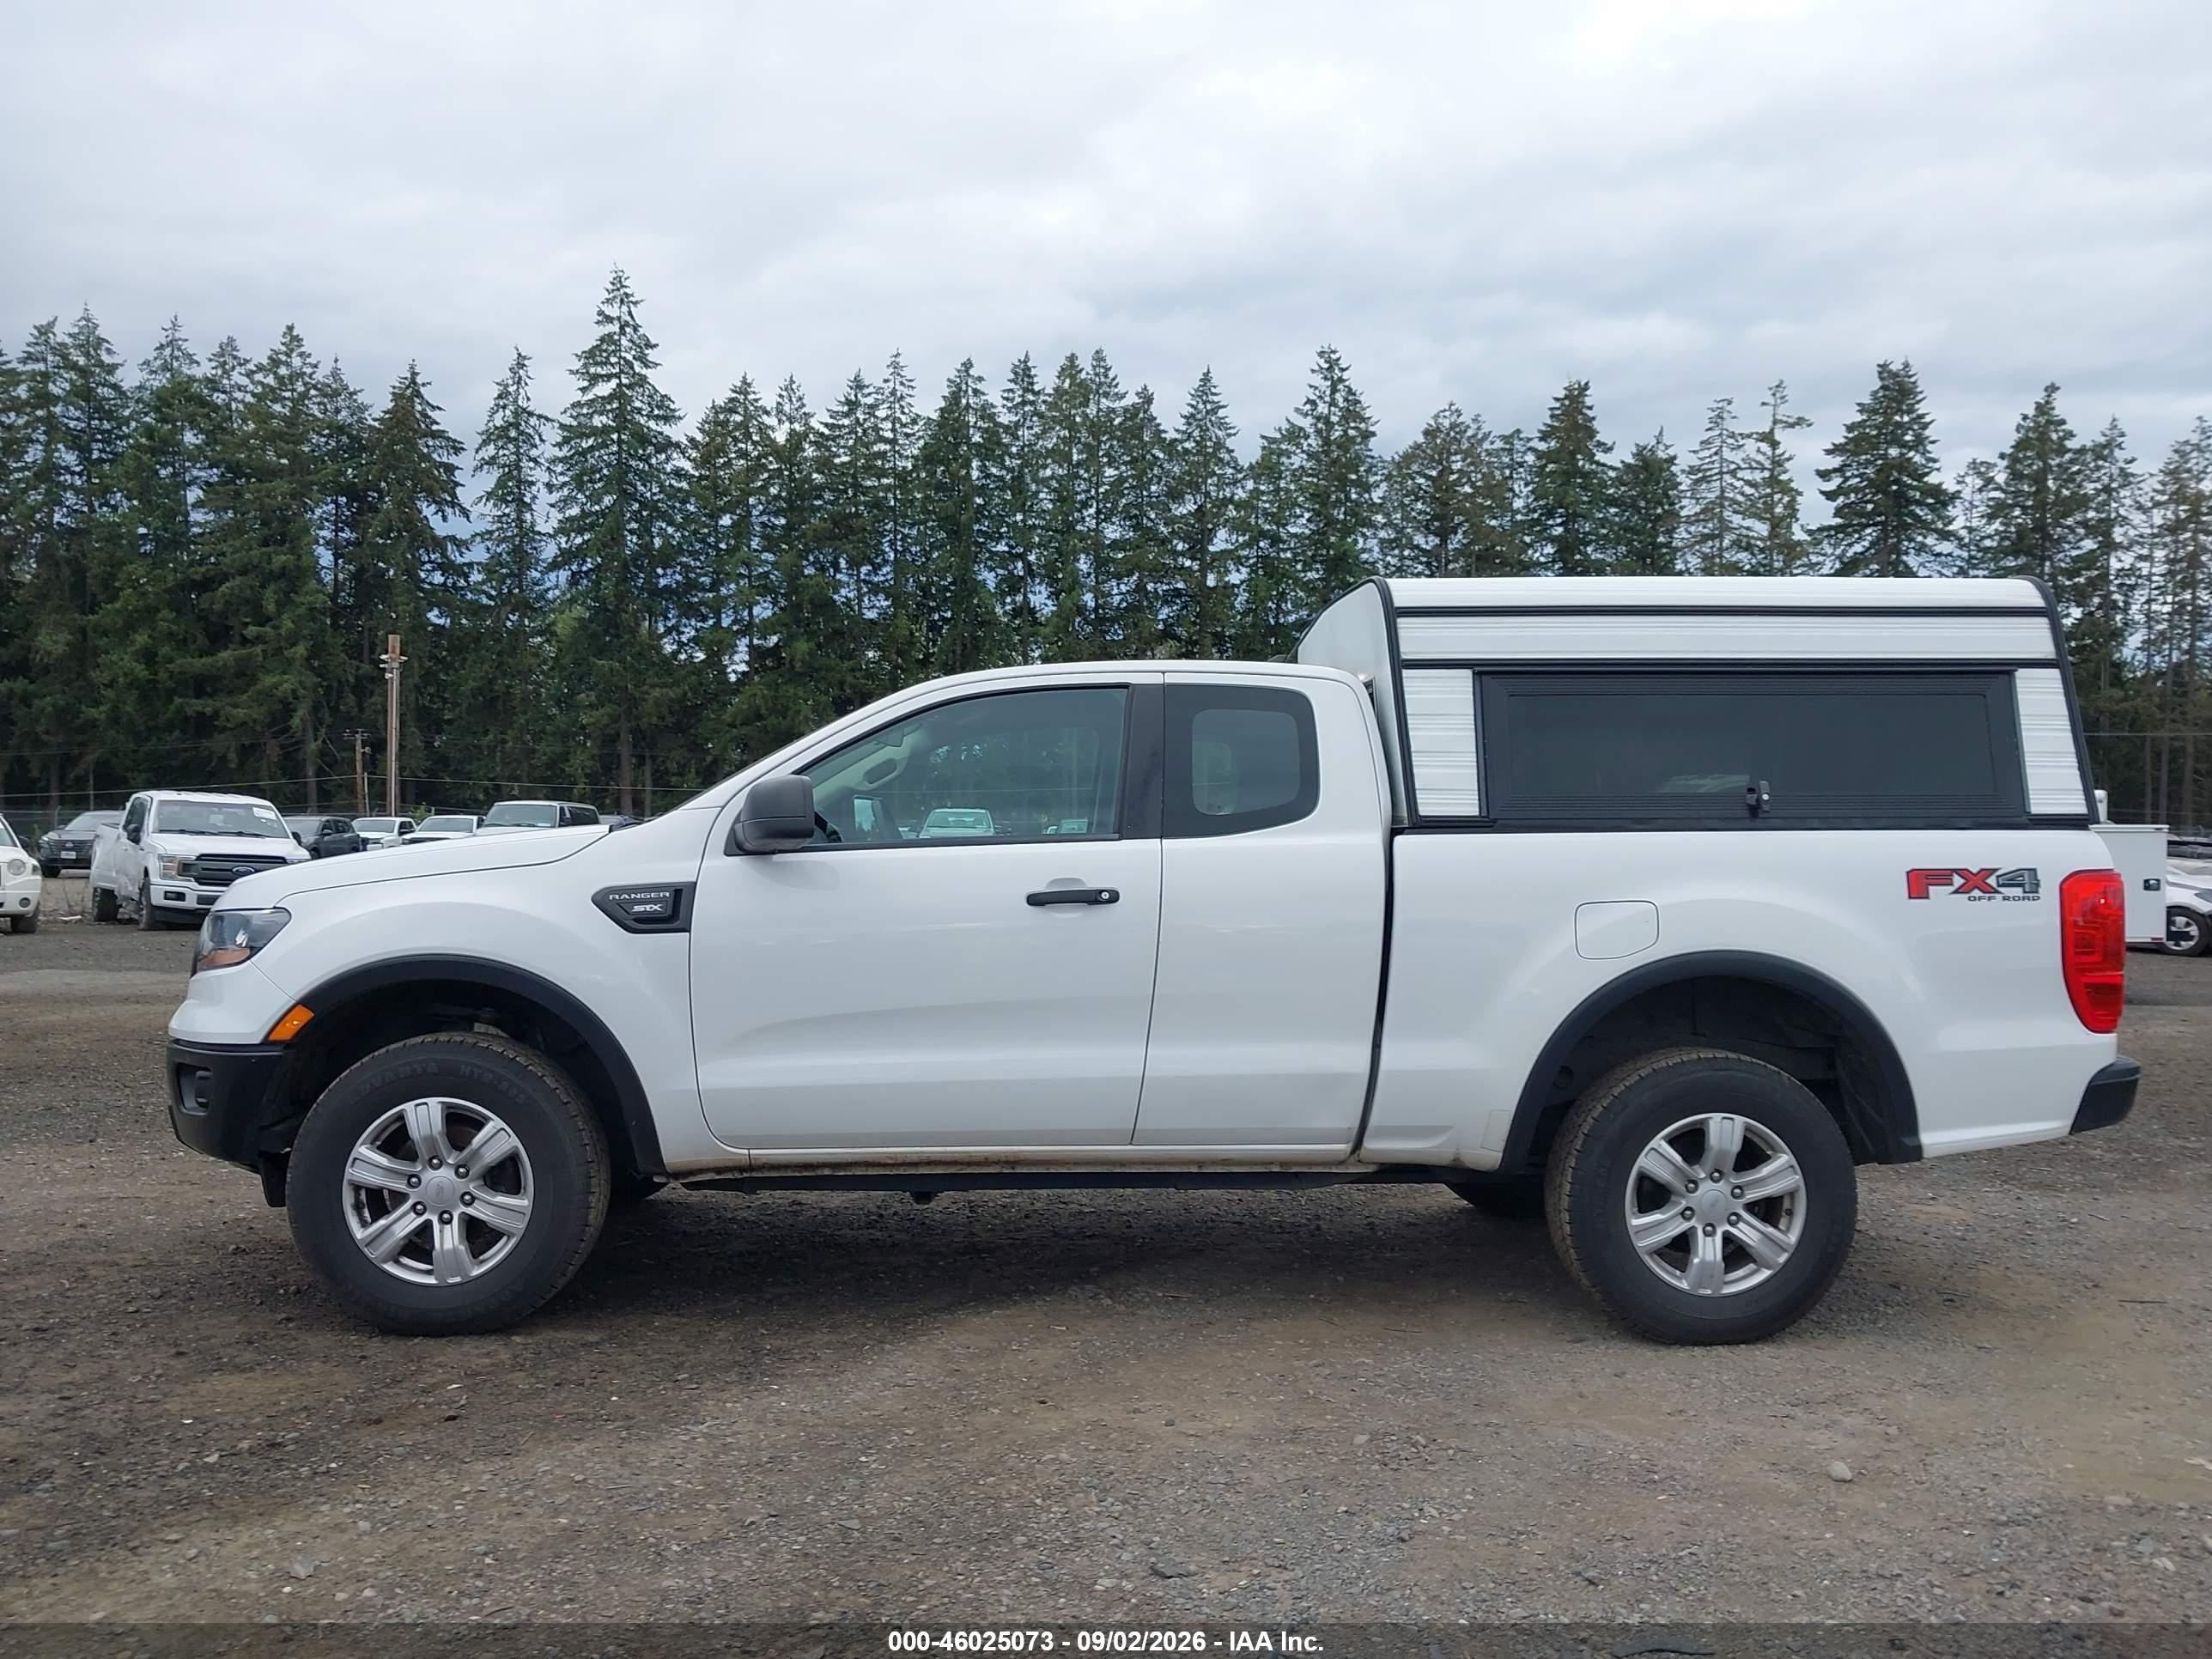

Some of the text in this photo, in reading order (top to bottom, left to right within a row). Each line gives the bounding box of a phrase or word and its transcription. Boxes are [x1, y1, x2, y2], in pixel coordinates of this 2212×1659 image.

[1905, 867, 2041, 900] FX4
[609, 891, 670, 901] RANGER
[631, 903, 665, 912] STX
